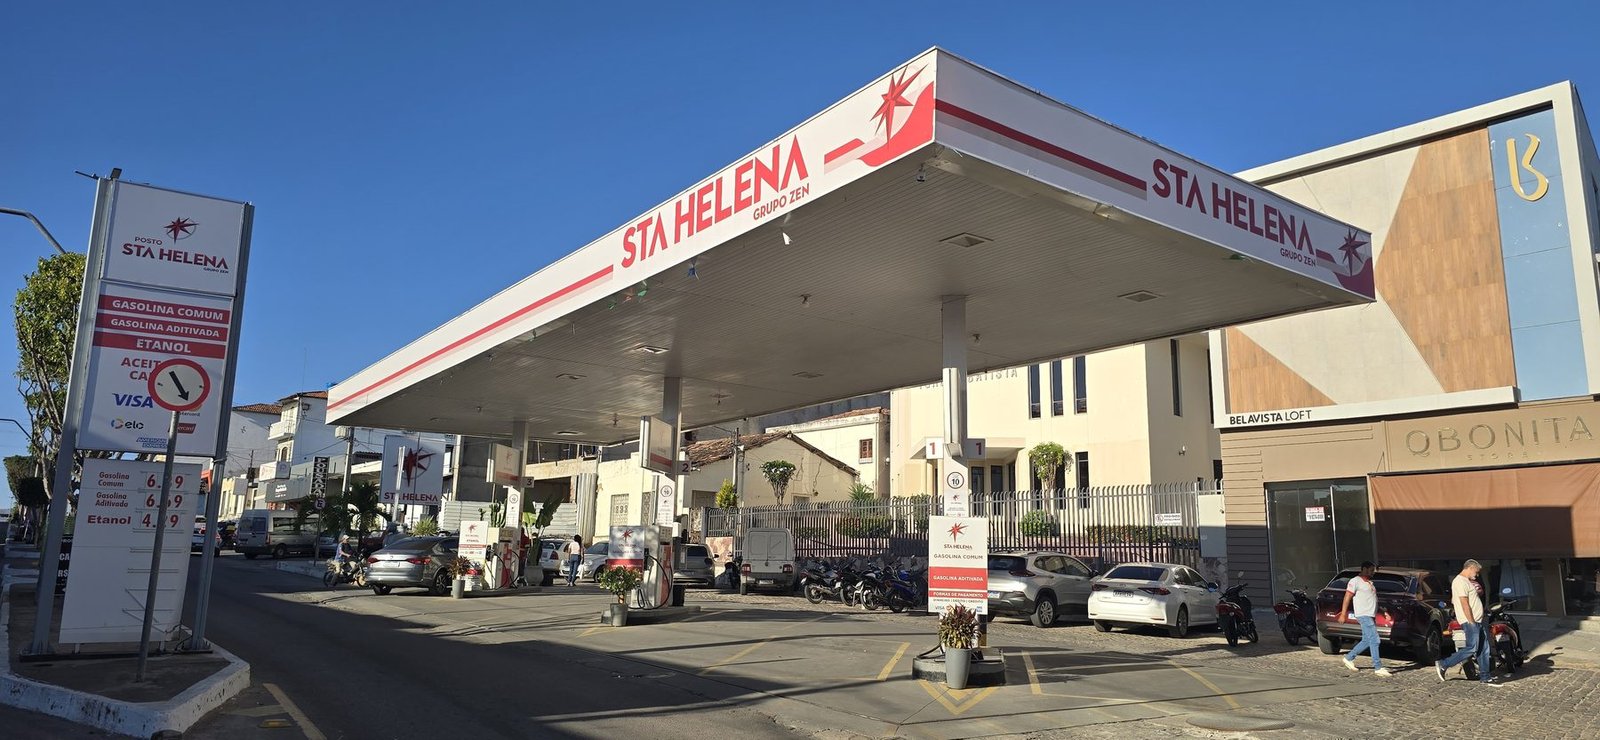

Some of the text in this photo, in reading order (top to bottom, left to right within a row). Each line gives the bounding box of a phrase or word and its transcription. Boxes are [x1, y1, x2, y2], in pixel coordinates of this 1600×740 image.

[621, 134, 809, 269] STA HELENA
[753, 183, 810, 221] GRUPO ZEN
[1152, 158, 1315, 256] STA HELENA
[134, 236, 163, 246] POSTO
[122, 243, 229, 270] STA HELENA
[1280, 248, 1316, 267] GRUPO ZEN
[112, 299, 224, 321] GASOLINA COMUM
[110, 318, 220, 338] GASOLINA ADITIVADA
[136, 338, 192, 354] ETANOL
[121, 357, 162, 369] ACEIT
[129, 370, 150, 381] CA
[112, 392, 154, 409] VISA
[1229, 409, 1312, 425] BELAVISTA LOFT
[125, 420, 144, 430] elo
[929, 442, 936, 455] 1
[975, 442, 982, 455] 1
[682, 463, 689, 472] 2
[99, 471, 130, 480] Gasolina
[146, 473, 184, 489] 6.9
[527, 478, 533, 486] 3
[951, 478, 960, 486] 10
[96, 491, 127, 500] Gasolina
[384, 492, 439, 502] ST HELENA
[95, 499, 129, 507] Aditivada
[87, 514, 132, 525] Etanol
[141, 513, 179, 528] 4.9
